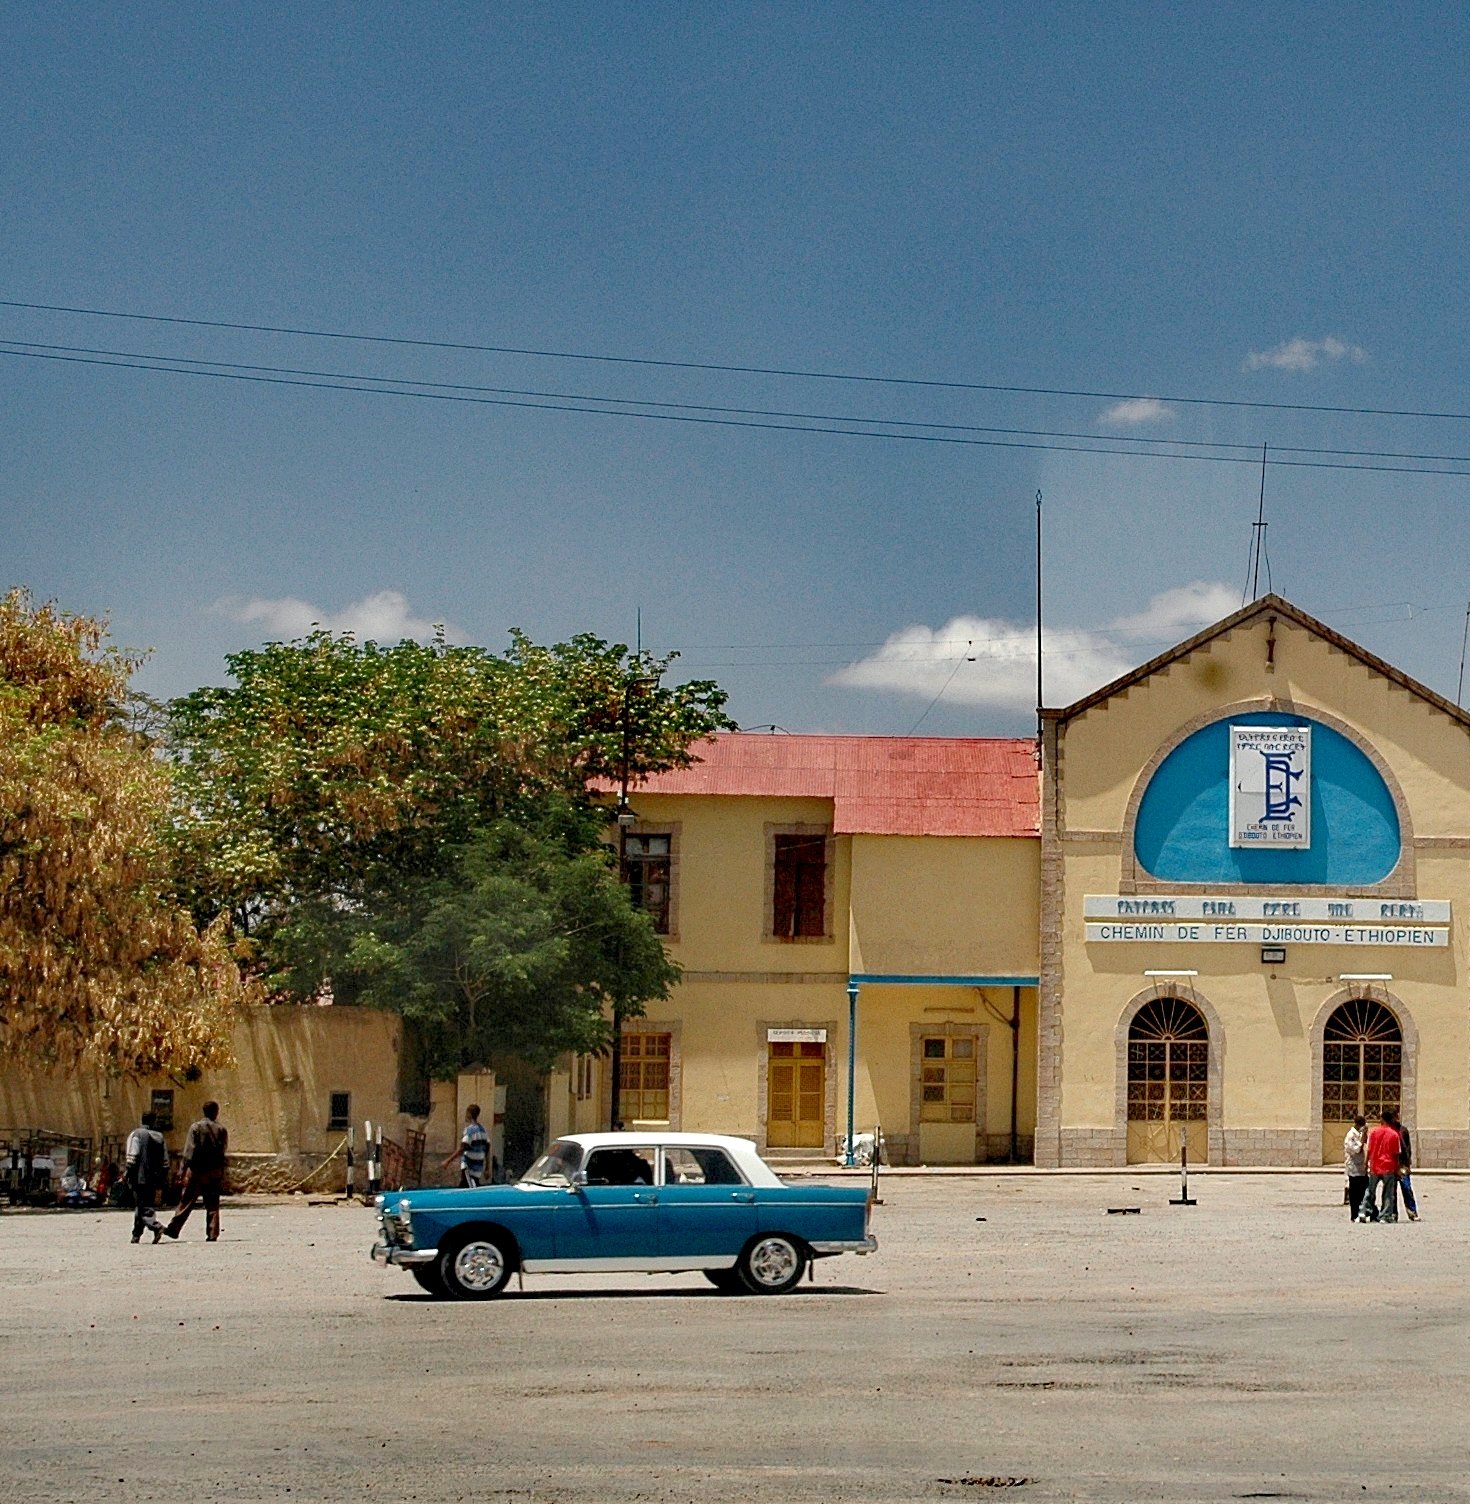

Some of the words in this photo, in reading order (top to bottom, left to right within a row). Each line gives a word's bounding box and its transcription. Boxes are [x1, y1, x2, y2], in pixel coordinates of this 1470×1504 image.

[1100, 926, 1165, 940] CHEMIN
[1178, 926, 1200, 940] DE
[1214, 927, 1248, 940] FER
